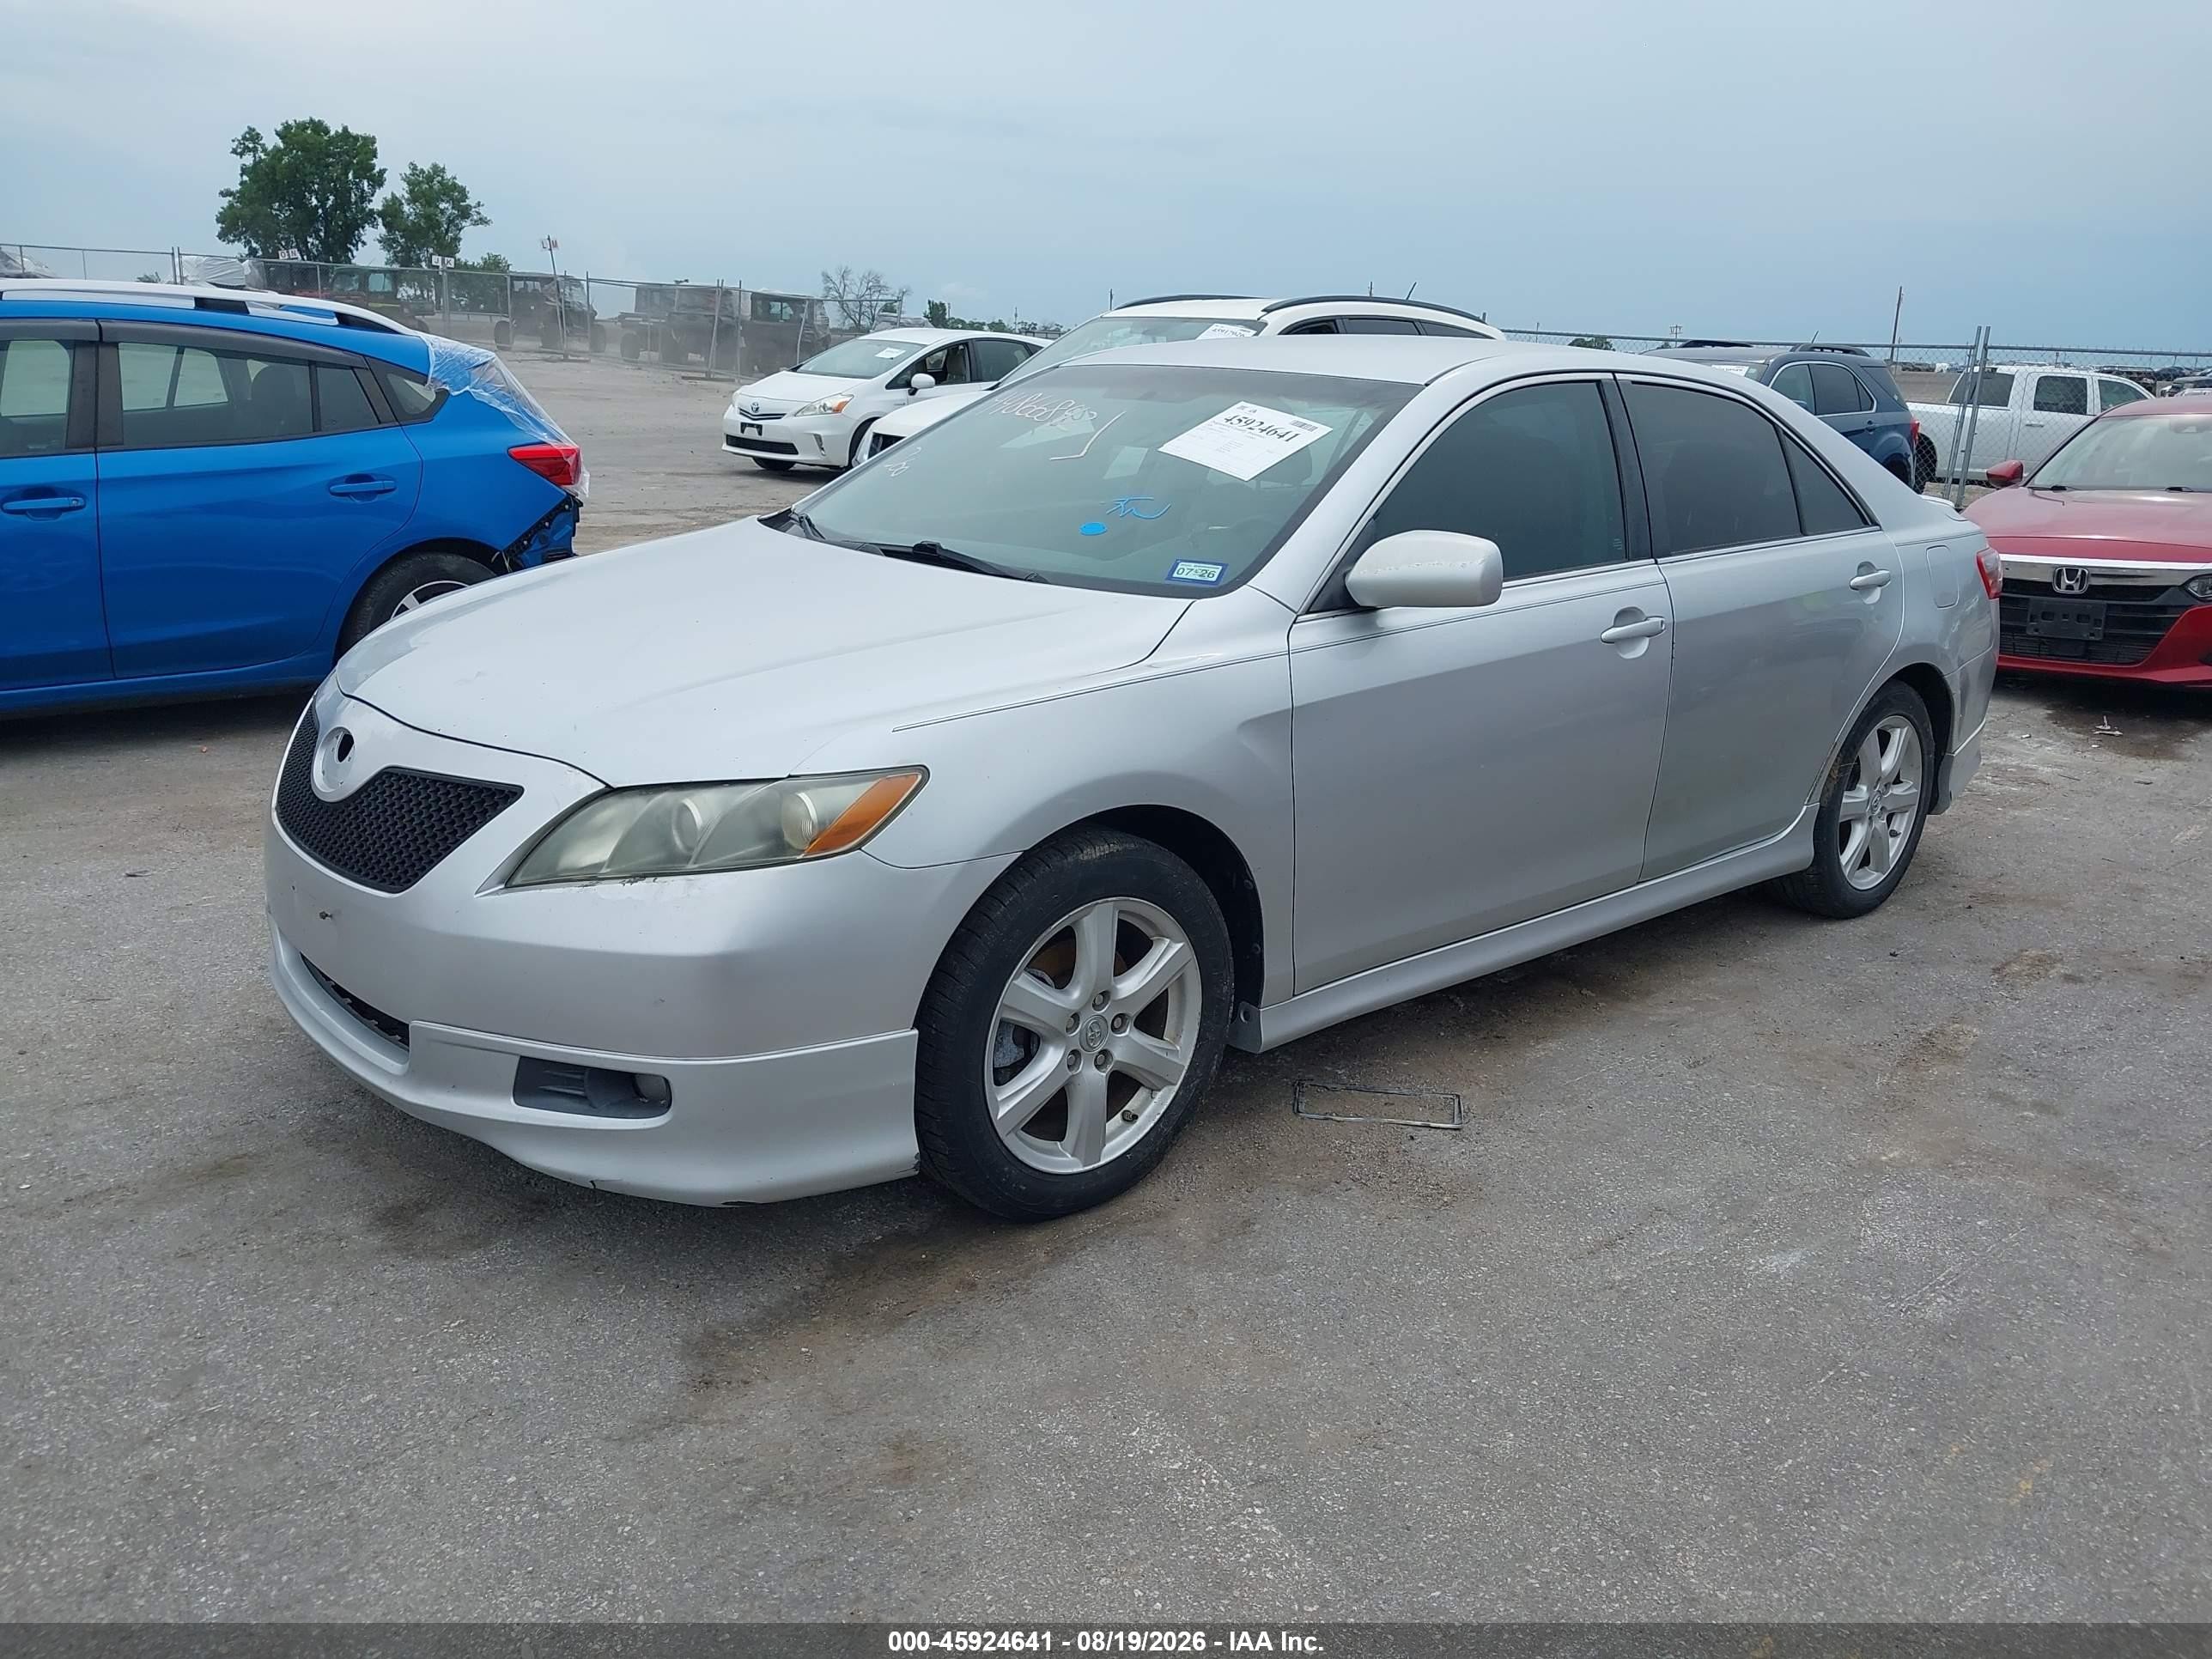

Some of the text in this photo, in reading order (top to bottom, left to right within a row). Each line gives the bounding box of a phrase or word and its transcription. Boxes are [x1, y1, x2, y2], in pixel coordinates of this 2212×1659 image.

[1224, 414, 1302, 442] 45924641
[1176, 567, 1218, 579] 07 26
